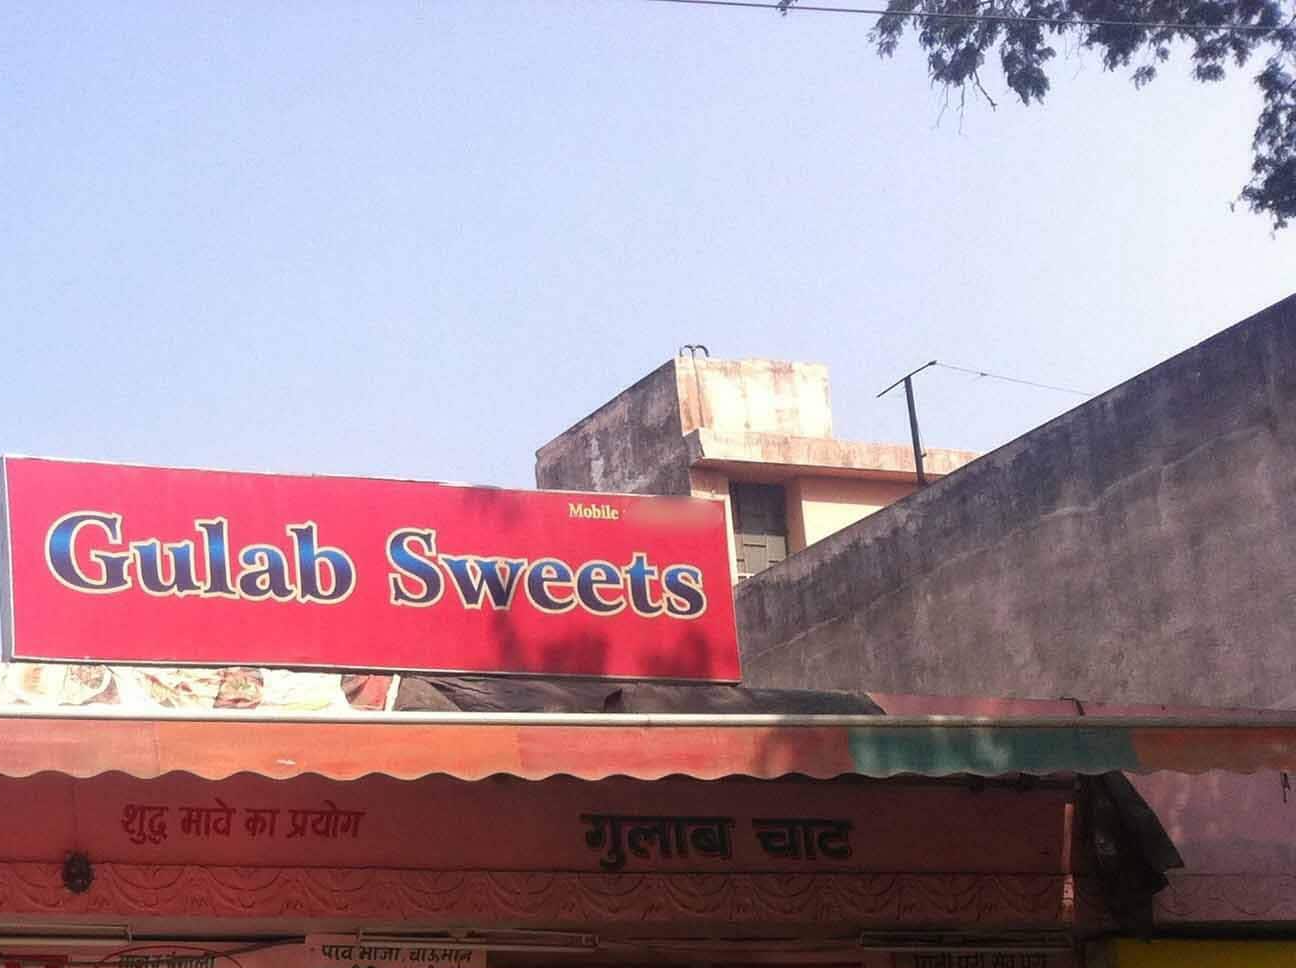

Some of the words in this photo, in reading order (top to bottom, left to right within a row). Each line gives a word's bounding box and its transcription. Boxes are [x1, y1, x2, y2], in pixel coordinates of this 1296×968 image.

[568, 503, 619, 520] Mobile
[47, 510, 356, 604] Gulab
[388, 527, 707, 621] Sweets
[179, 799, 236, 838] मावे
[244, 805, 278, 838] का
[288, 801, 366, 839] प्रयोग
[581, 812, 736, 870] गुलाब
[752, 817, 853, 861] चाट
